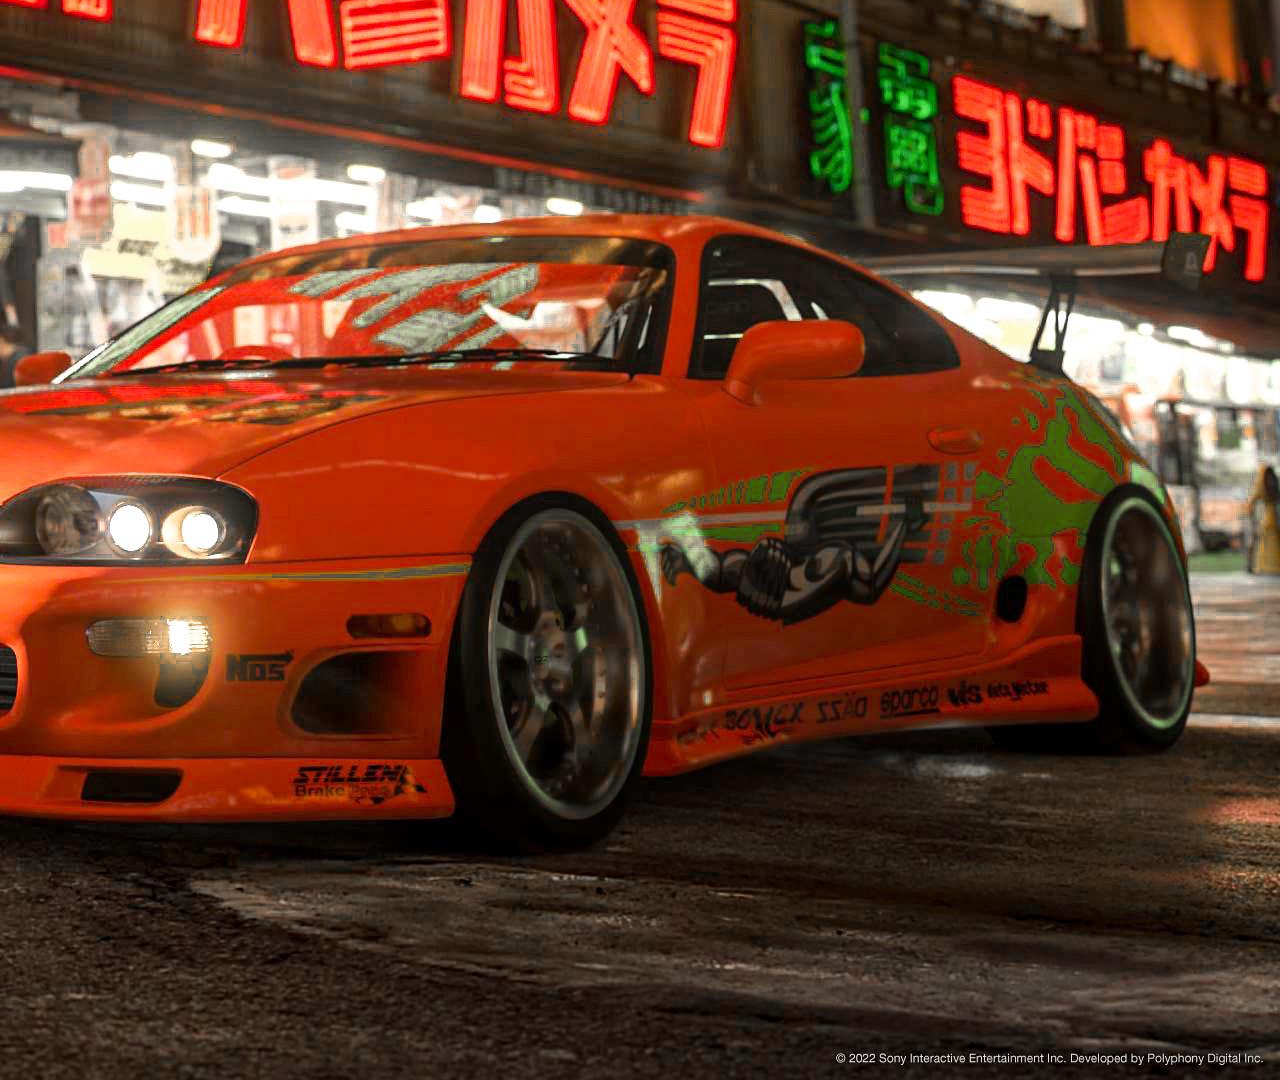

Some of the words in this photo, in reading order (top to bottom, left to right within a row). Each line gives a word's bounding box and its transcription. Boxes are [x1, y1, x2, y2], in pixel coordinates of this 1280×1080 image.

[950, 73, 1271, 283] ヨドバシカメラ
[226, 651, 288, 682] NOS
[292, 764, 405, 783] STILLEN
